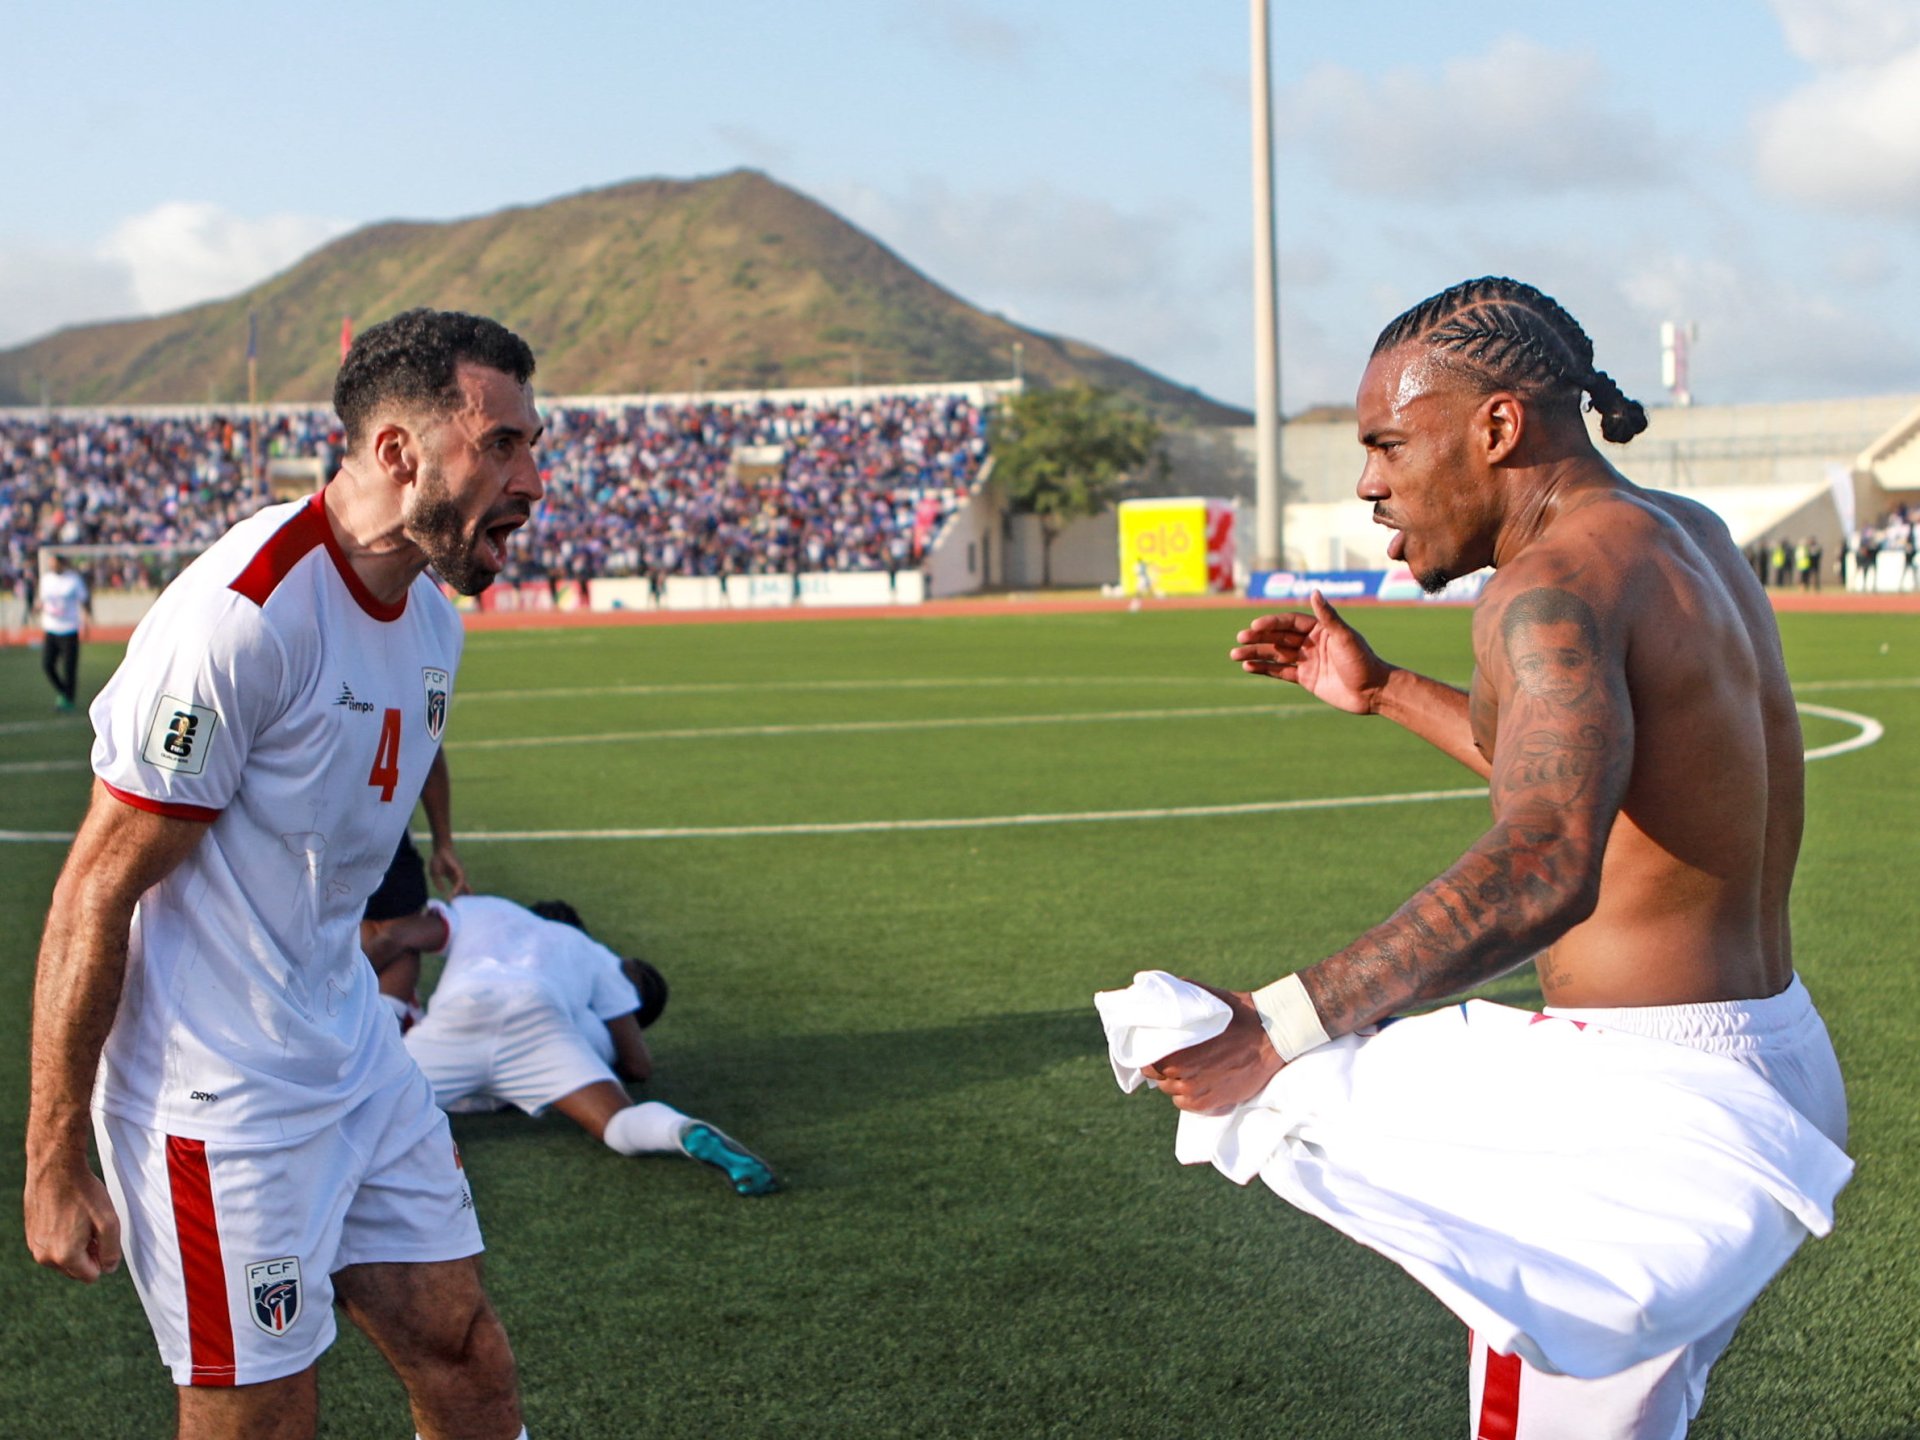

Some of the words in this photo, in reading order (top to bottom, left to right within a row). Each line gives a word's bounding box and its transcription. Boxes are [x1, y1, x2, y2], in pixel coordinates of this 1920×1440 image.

[424, 671, 446, 684] FCF
[368, 708, 401, 802] 4
[251, 1261, 294, 1279] FCF
